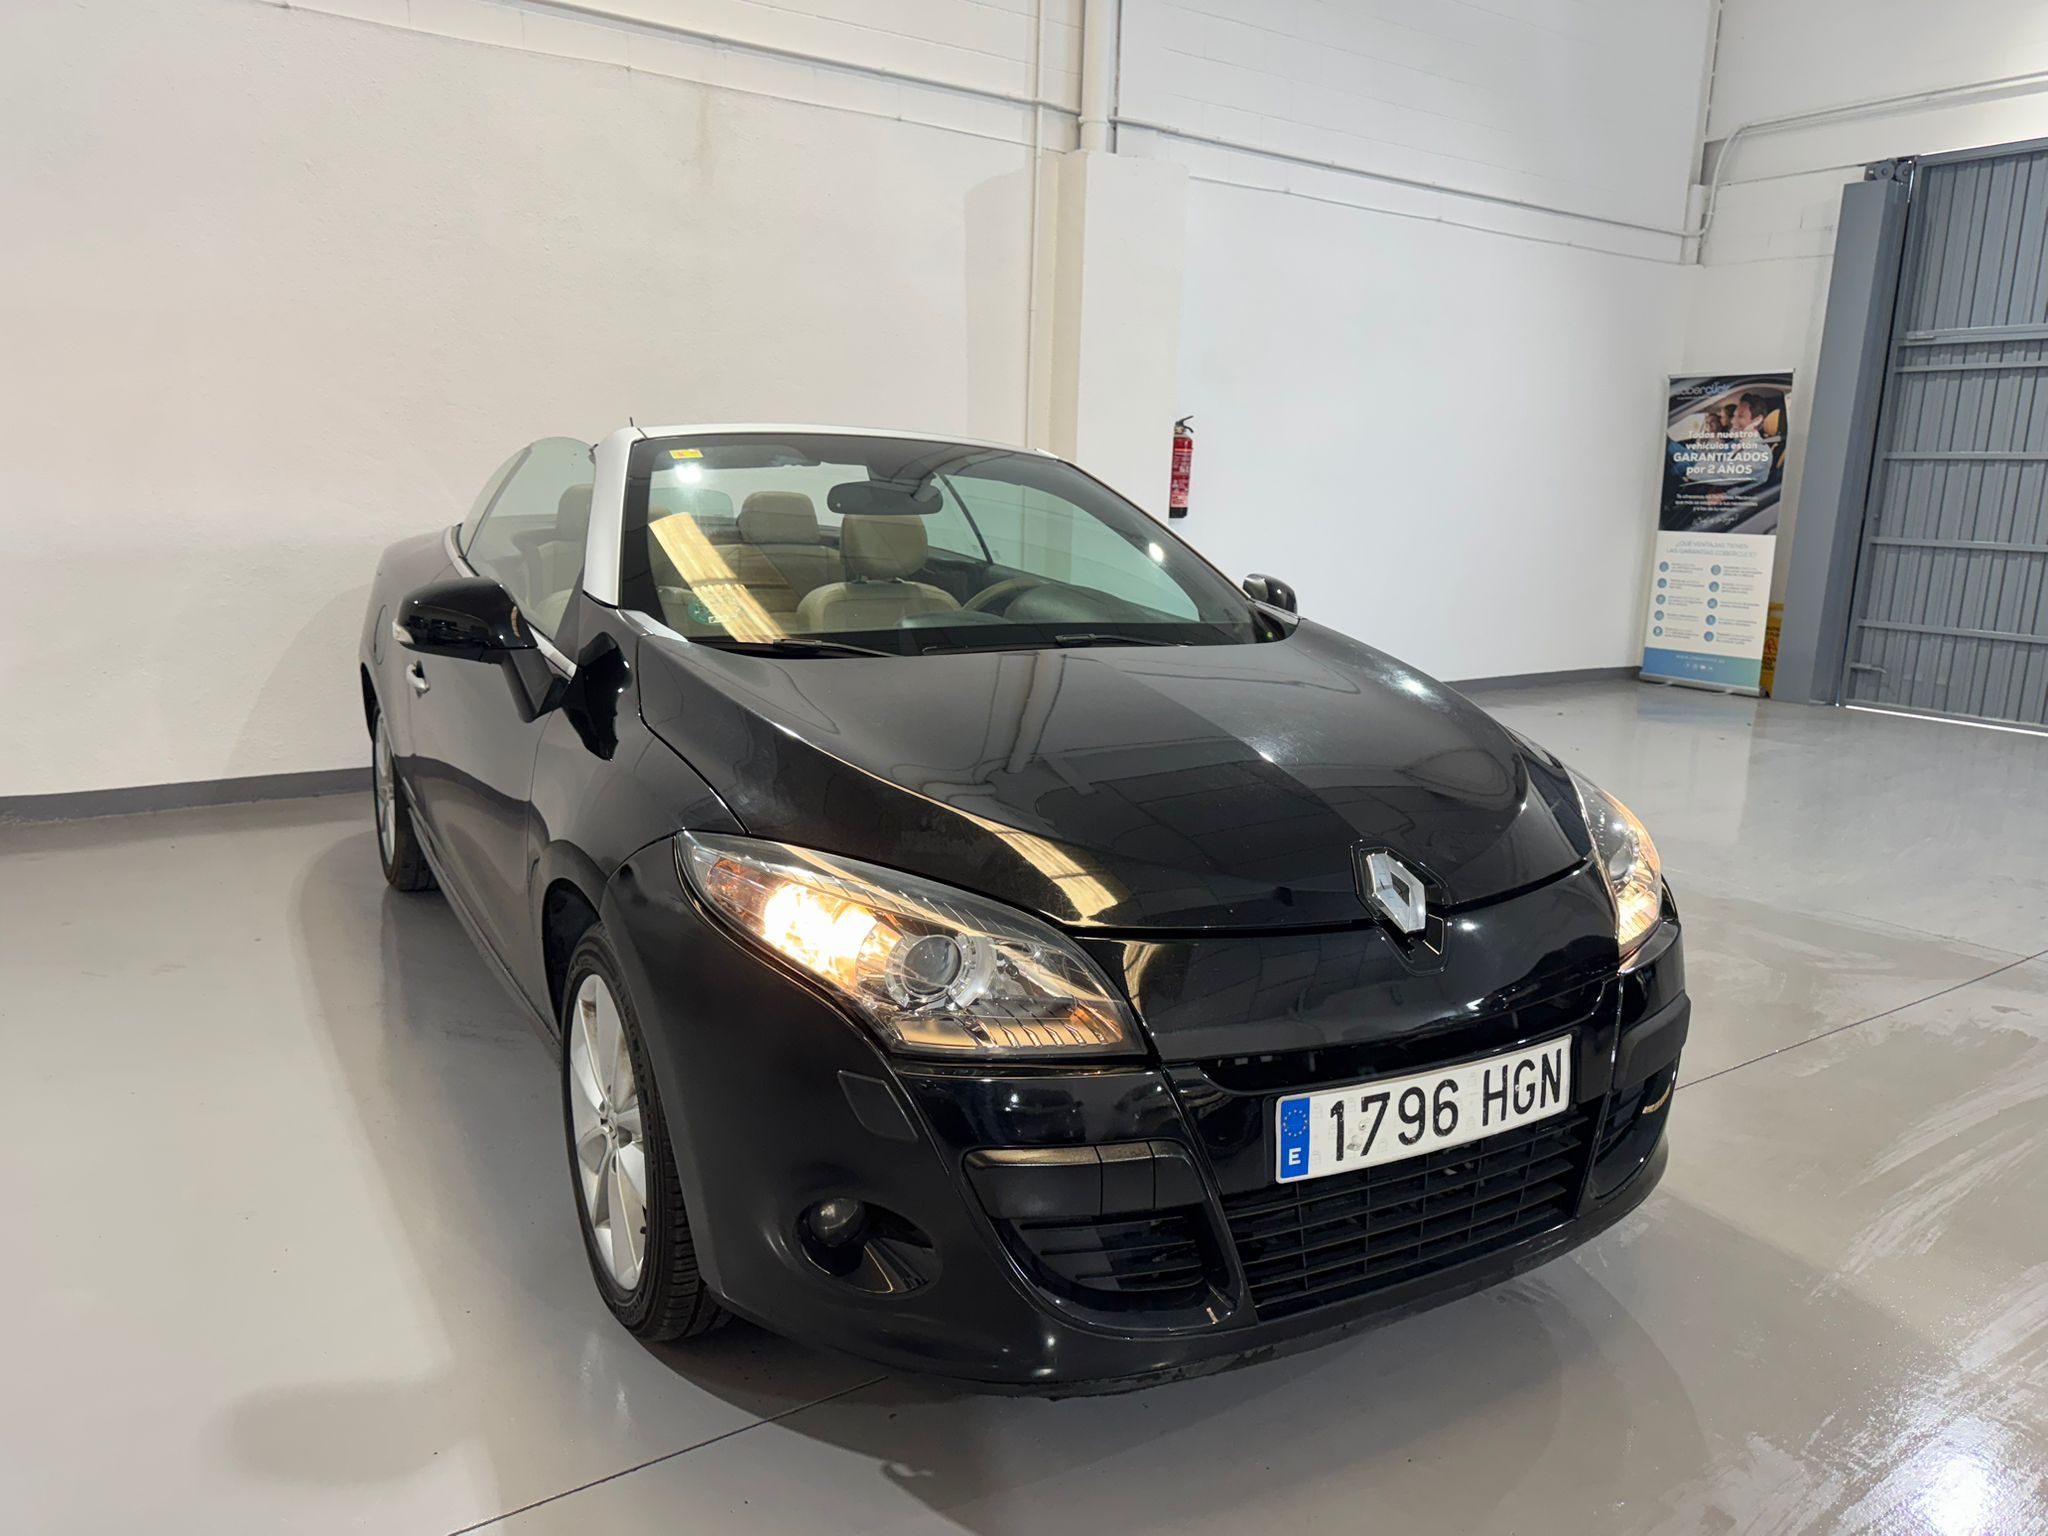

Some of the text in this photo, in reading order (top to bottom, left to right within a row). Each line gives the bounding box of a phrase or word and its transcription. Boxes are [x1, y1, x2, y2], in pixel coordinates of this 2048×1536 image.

[1688, 431, 1715, 439] Todos
[1686, 441, 1758, 449] vehículos están
[1673, 452, 1769, 462] GARANTIZADOS
[1686, 462, 1753, 476] por 2 AÑOS
[1330, 1048, 1562, 1161] 1796 HGN
[1288, 1147, 1302, 1166] E
